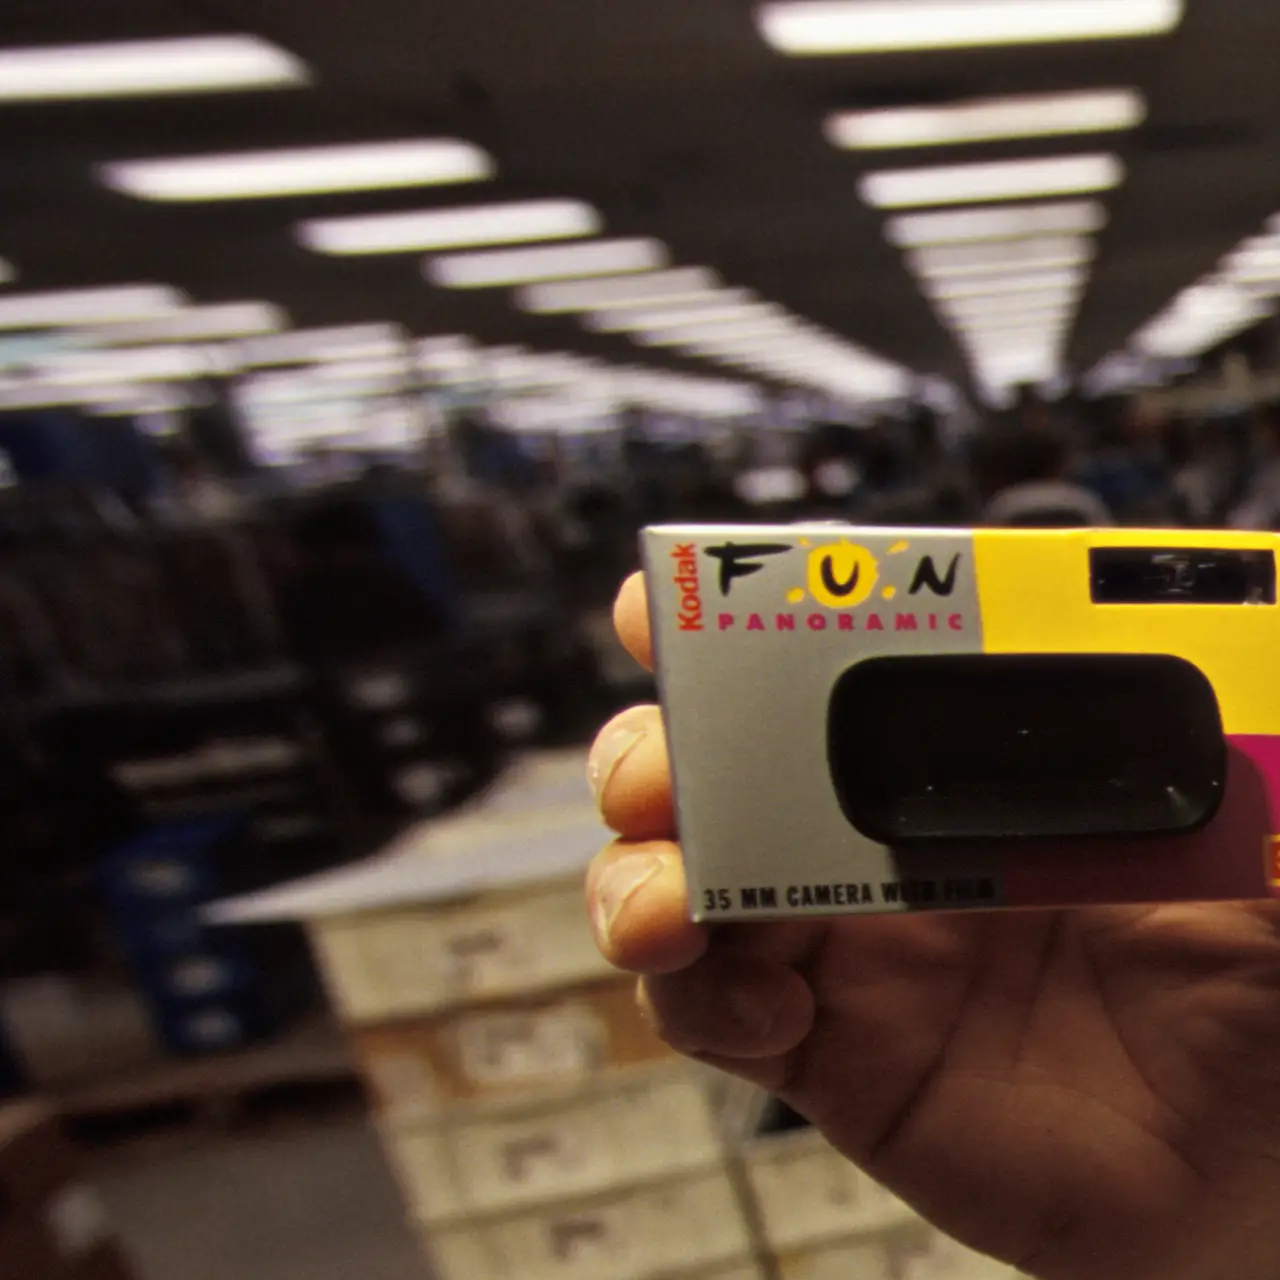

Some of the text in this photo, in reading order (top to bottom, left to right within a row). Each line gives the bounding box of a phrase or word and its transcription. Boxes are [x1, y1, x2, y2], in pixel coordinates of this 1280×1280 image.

[672, 543, 704, 631] Kodak
[717, 612, 963, 631] PANORAMIC
[704, 889, 732, 911] 35
[741, 886, 777, 909] MM
[786, 882, 873, 907] CAMERA
